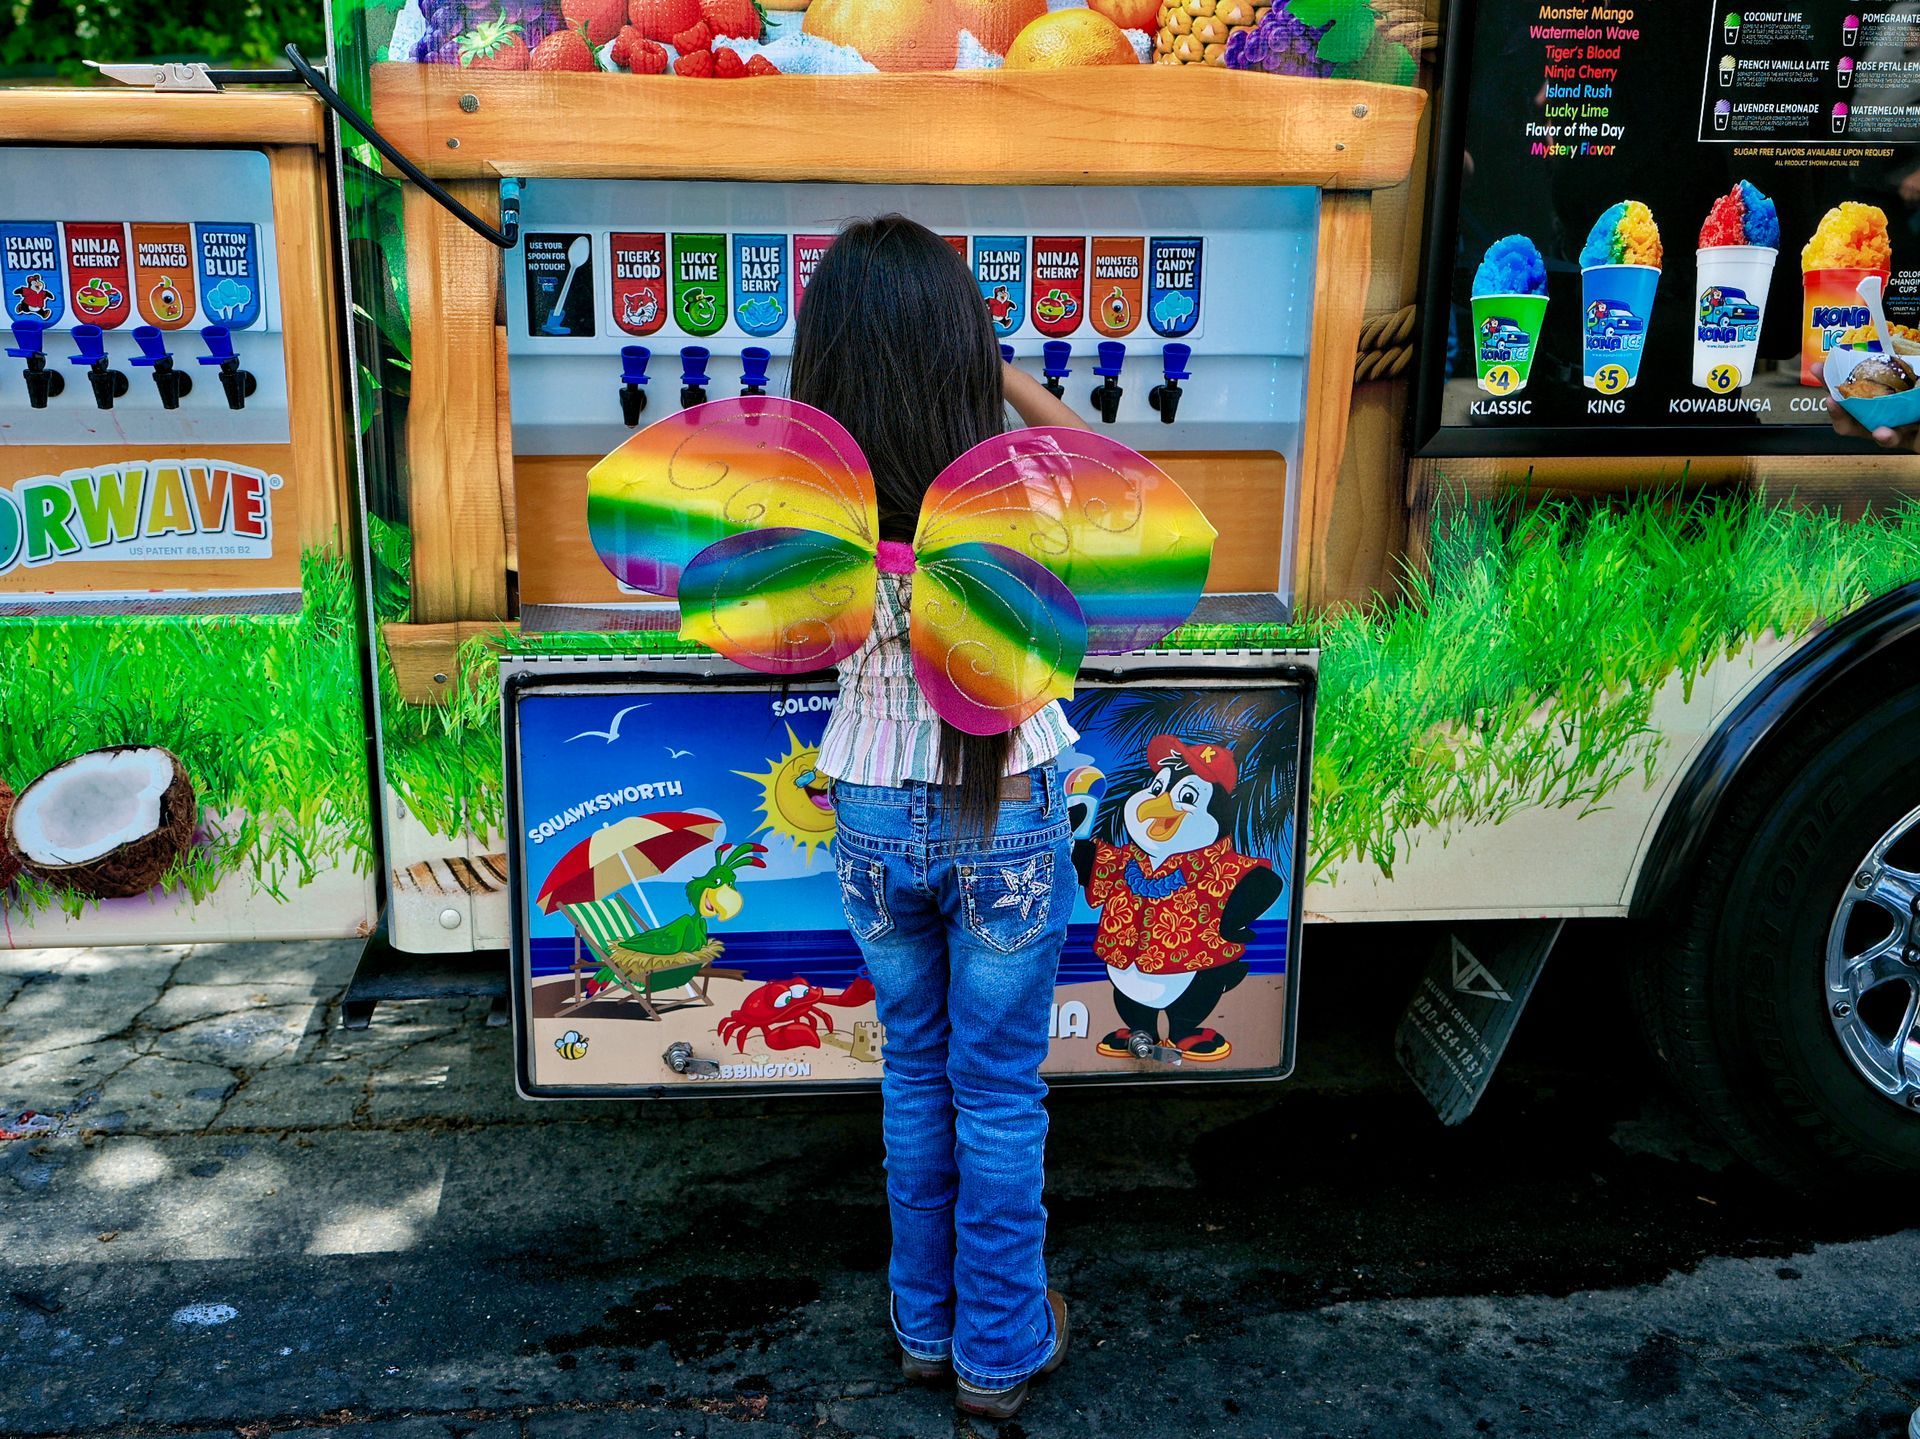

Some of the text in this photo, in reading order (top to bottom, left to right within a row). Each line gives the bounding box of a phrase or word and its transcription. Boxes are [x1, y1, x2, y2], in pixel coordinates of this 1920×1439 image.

[1539, 6, 1634, 23] Monster Mango
[1744, 12, 1802, 22] COCONUT LIME
[1862, 14, 1920, 23] POMEGRANATE
[1530, 26, 1640, 40] Watermelon Wave
[1545, 45, 1621, 62] Tiger's Blood
[1738, 60, 1830, 70] FRENCH VANILLA LATTE
[1856, 61, 1878, 70] ROSE
[1878, 62, 1902, 71] PETAL
[1544, 65, 1618, 82] Ninja Cherry
[1545, 84, 1612, 98] Island Rush
[1545, 104, 1609, 120] Lucky Lime
[1733, 104, 1820, 113] LAVENDER LEMONADE
[1850, 106, 1905, 115] WATERMELON
[1526, 122, 1625, 140] Flavor of the Day
[1530, 142, 1616, 159] Mystery Flavor
[1734, 148, 1894, 157] SUGAR FREE FLAVORS AVAILABLE UPON REQUEST
[5, 237, 53, 251] ISLAND
[202, 233, 247, 244] COTTON
[71, 238, 120, 254] NINJA
[138, 244, 186, 254] MONSTER
[204, 245, 247, 258] CANDY
[544, 242, 563, 250] YOUR
[1156, 248, 1196, 258] COTTON
[8, 252, 55, 270] RUSH
[72, 254, 120, 267] CHERRY
[140, 254, 188, 267] MANGO
[616, 250, 660, 263] TIGER'S
[680, 252, 718, 264] LUCKY
[741, 247, 780, 262] BLUE
[800, 249, 828, 260] WAT
[979, 251, 1020, 264] ISLAND
[1036, 252, 1080, 266] NINJA
[1096, 256, 1138, 266] MONSTER
[206, 260, 249, 276] BLUE
[616, 264, 661, 279] BLOOD
[741, 264, 780, 279] RASP
[980, 264, 1020, 281] RUSH
[1036, 267, 1079, 279] CHERRY
[1096, 266, 1139, 278] MANGO
[1156, 260, 1194, 272] CANDY
[681, 266, 718, 281] LIME
[1156, 273, 1194, 288] BLUE
[742, 280, 780, 292] BERRY
[1812, 306, 1871, 329] KONA
[1698, 326, 1759, 343] KONA ICE
[1585, 335, 1642, 350] KONA ICE
[1480, 348, 1528, 362] KONA ICE
[1489, 370, 1510, 390] $4
[1598, 370, 1619, 390] $5
[1710, 368, 1731, 388] $6
[1470, 400, 1532, 415] KLASSIC
[1587, 400, 1626, 414] KING
[1668, 398, 1772, 413] KOWABUNGA
[129, 548, 144, 556] US
[146, 546, 184, 556] PATENT
[528, 780, 684, 844] SQUAWKSWORTH
[1414, 996, 1484, 1079] 800-654-1857
[687, 1062, 812, 1081] BBINGTON
